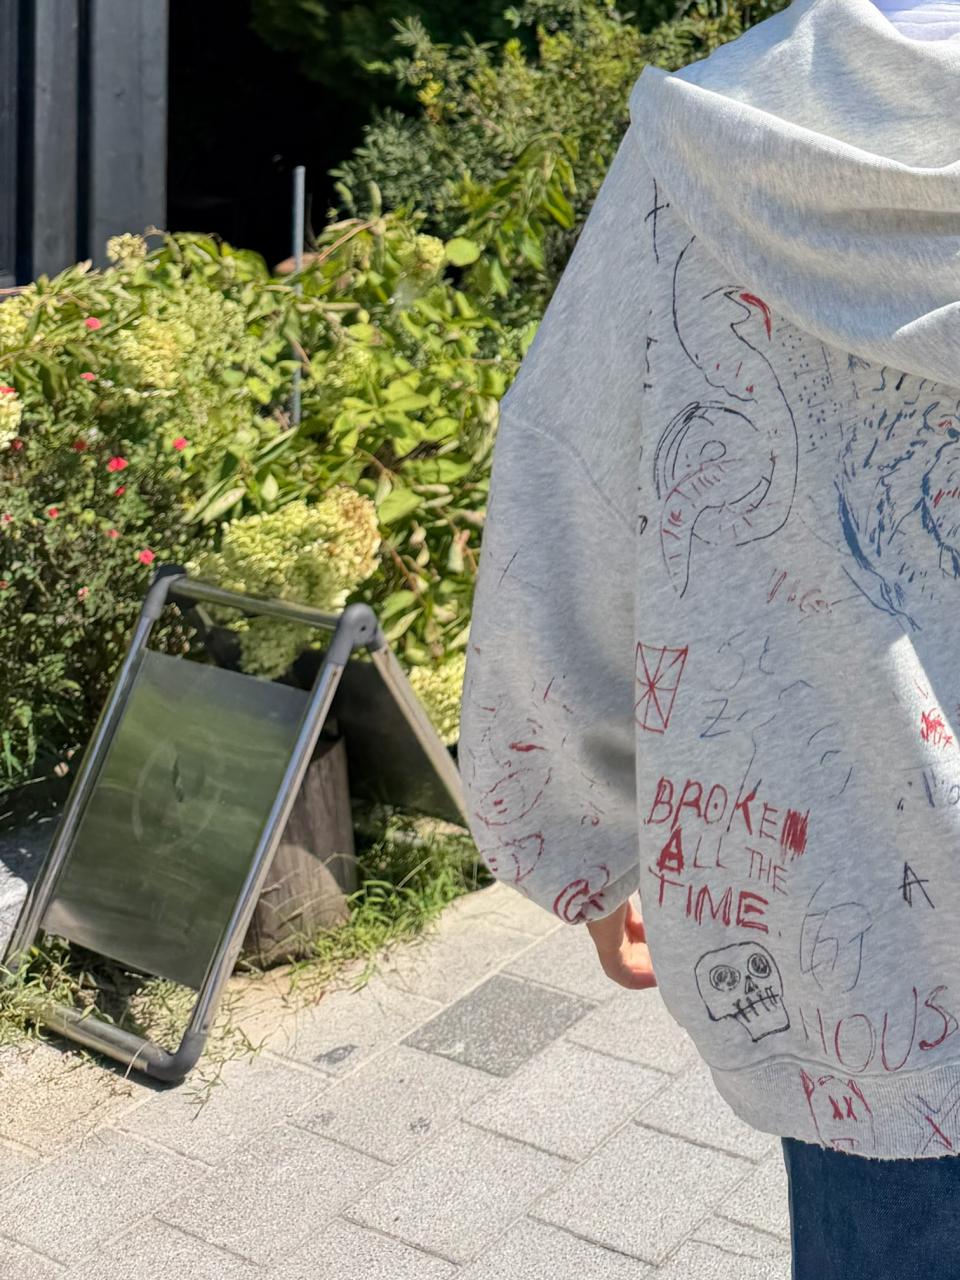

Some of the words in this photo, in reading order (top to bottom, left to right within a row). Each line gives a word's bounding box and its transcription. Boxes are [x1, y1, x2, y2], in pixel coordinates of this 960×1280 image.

[647, 776, 810, 864] BROKEN
[656, 824, 728, 876] ALL
[745, 845, 788, 896] THE
[648, 866, 769, 934] TIME
